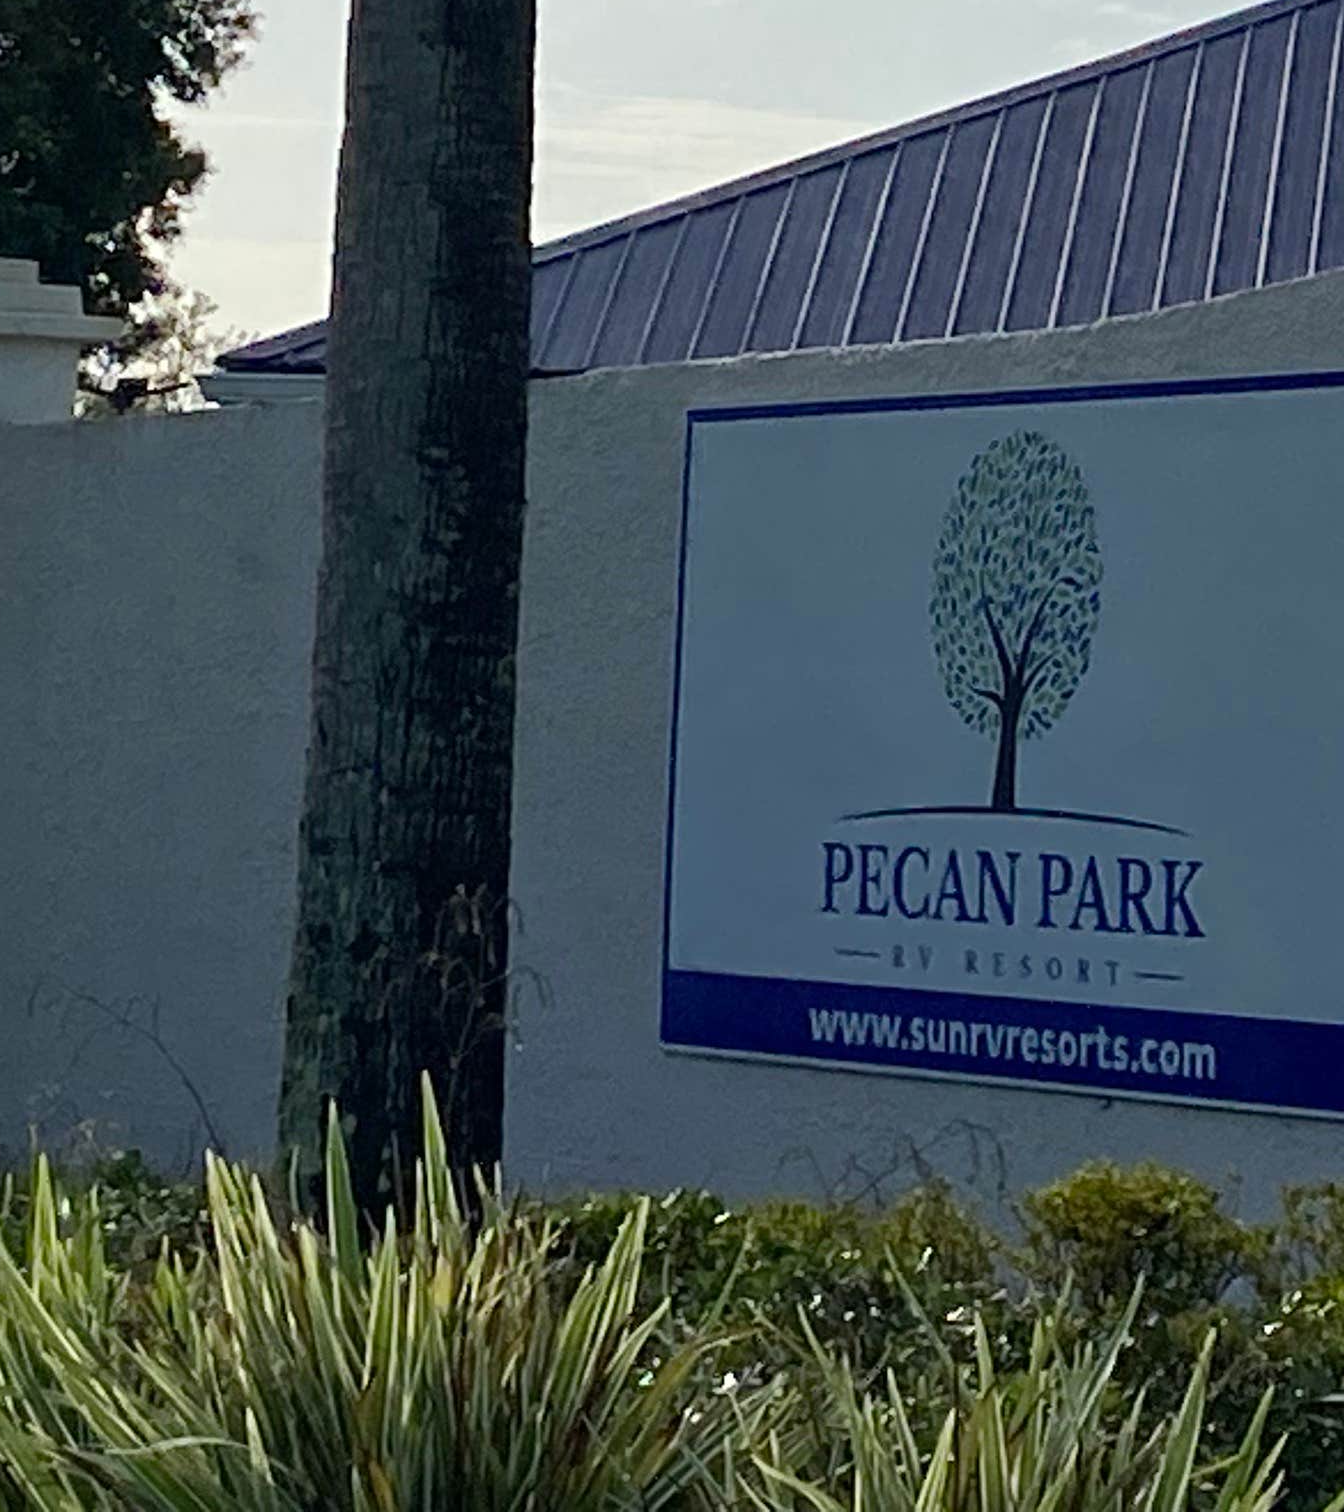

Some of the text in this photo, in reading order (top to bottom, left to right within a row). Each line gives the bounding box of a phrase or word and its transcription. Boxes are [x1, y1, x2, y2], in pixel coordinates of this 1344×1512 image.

[820, 841, 1206, 938] PECAN PARK
[891, 944, 1121, 987] RV RESORT
[808, 1006, 1217, 1080] www.sunrvresorts.com
